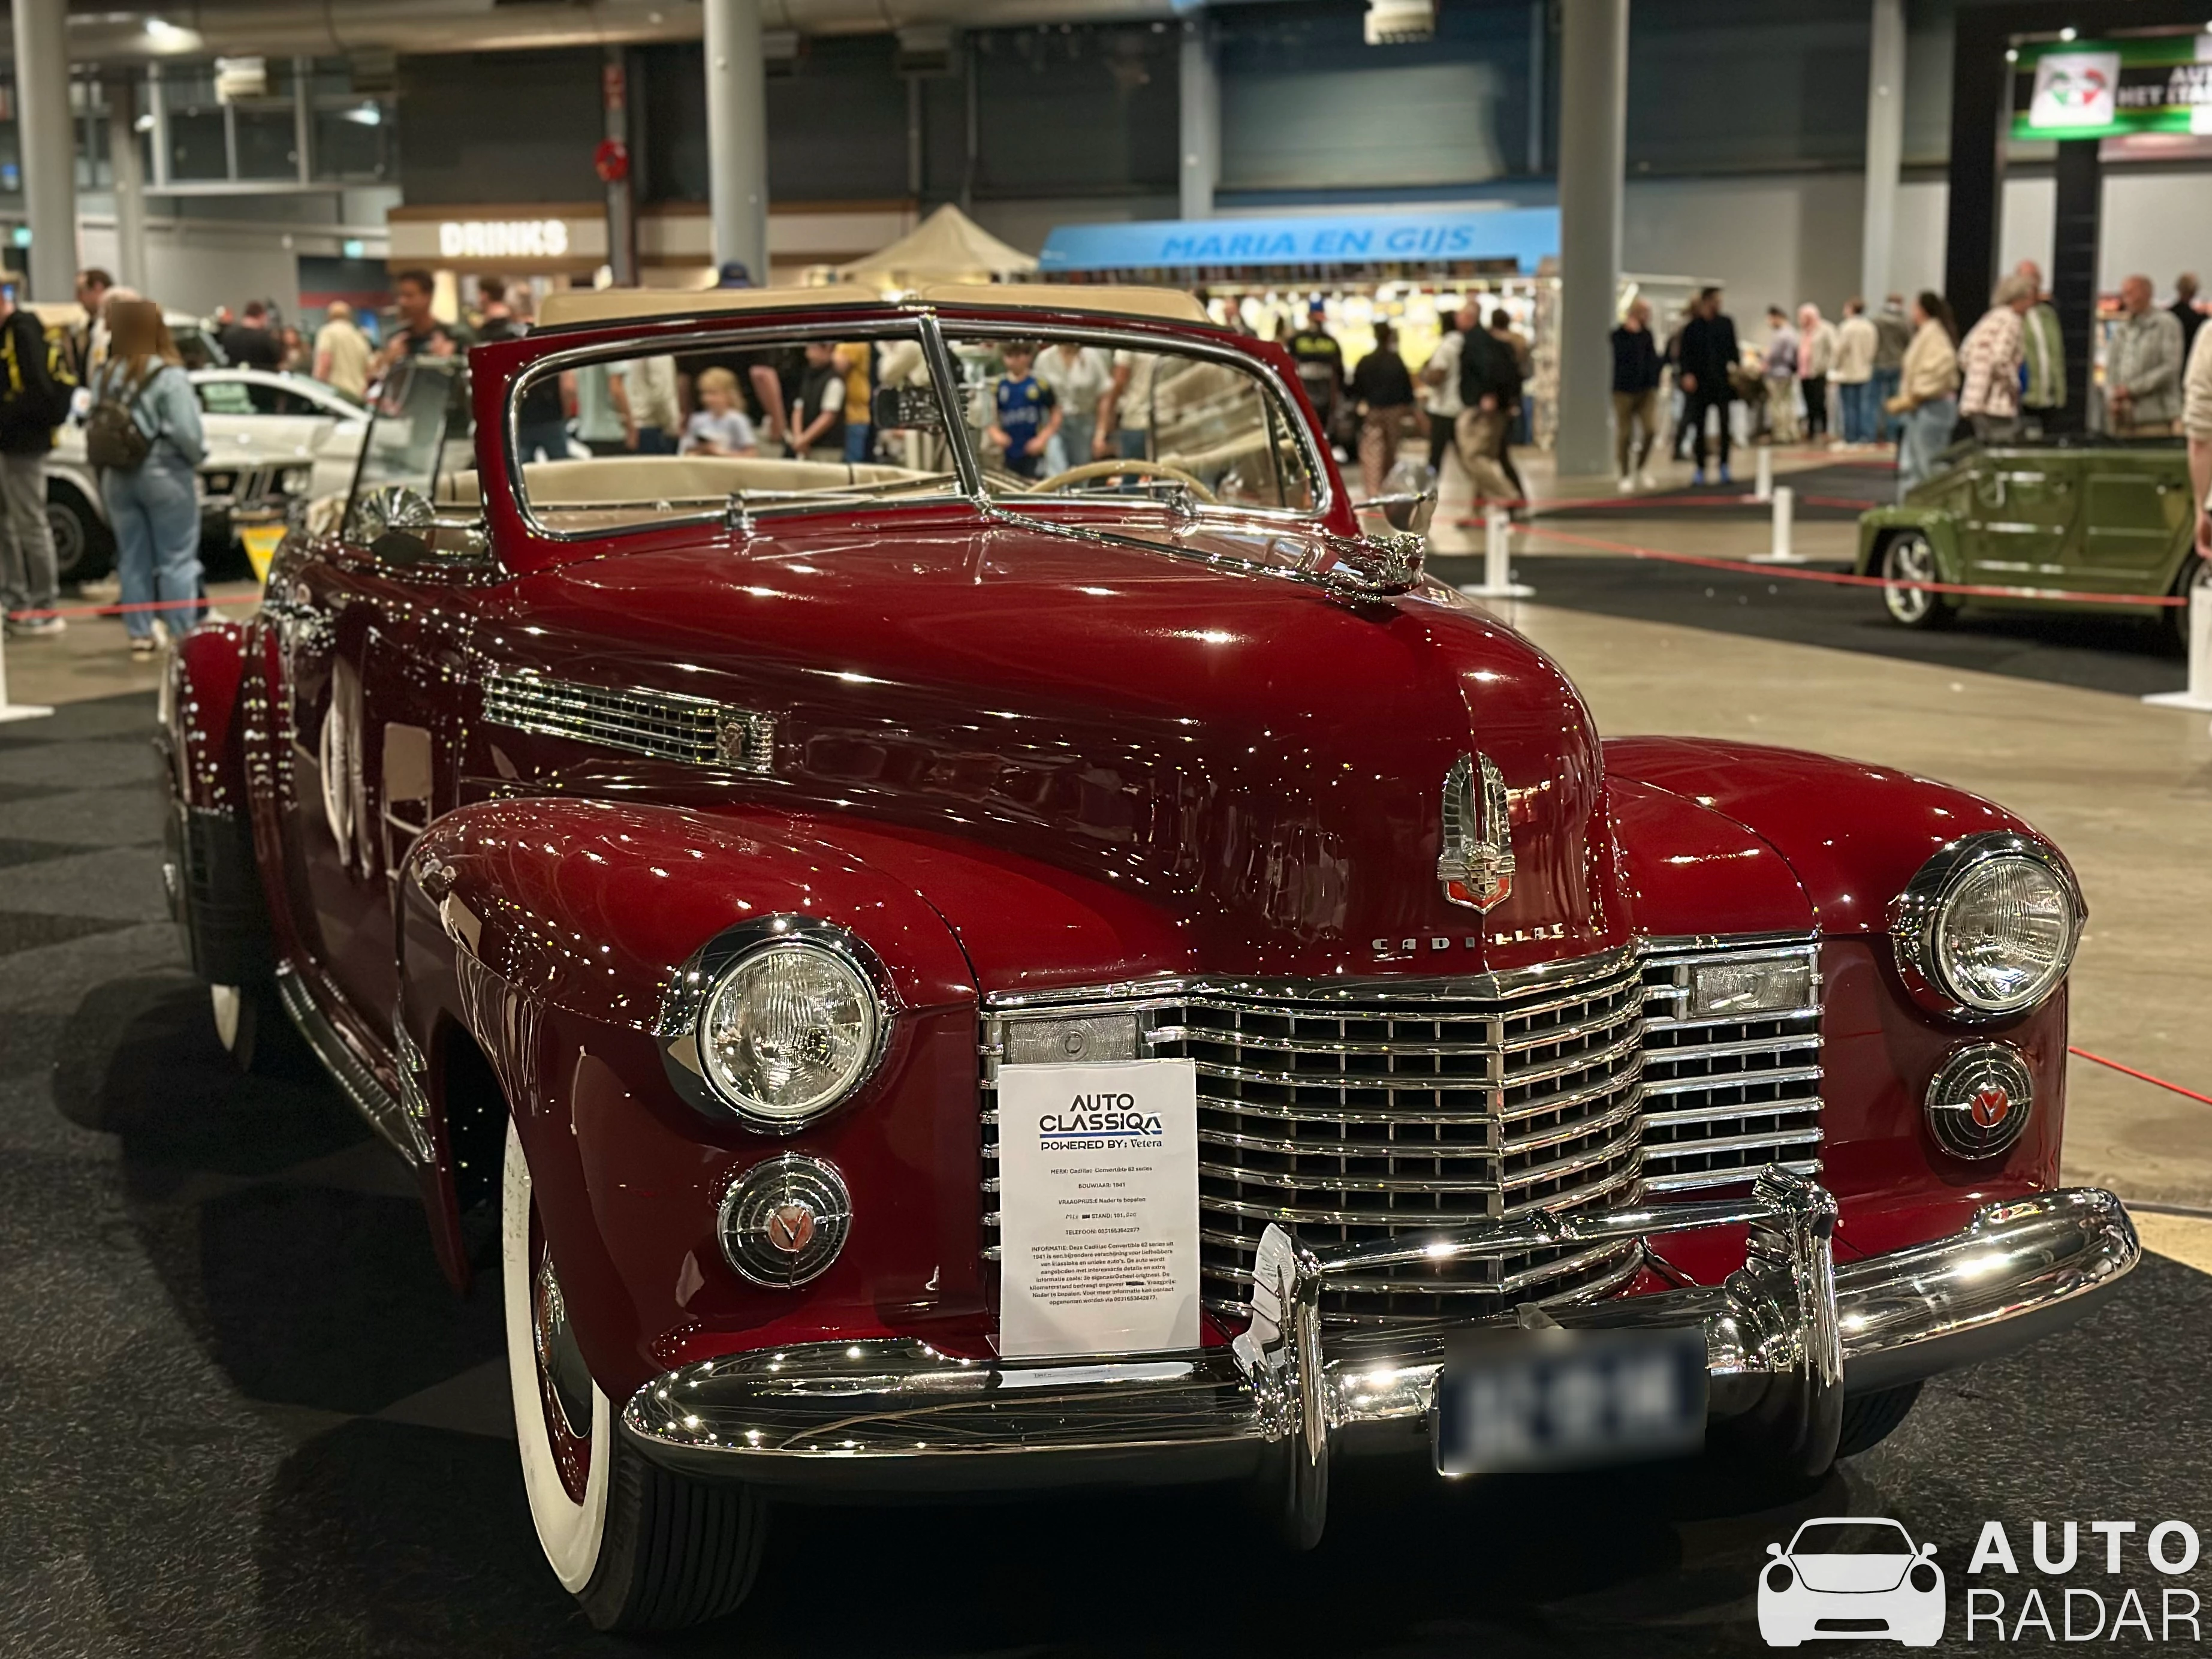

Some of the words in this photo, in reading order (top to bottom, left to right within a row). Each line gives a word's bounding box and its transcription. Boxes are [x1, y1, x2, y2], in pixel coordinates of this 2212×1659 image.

[439, 219, 568, 257] DRINKS
[1162, 231, 1297, 258] MARIA
[1309, 228, 1372, 254] EN
[1386, 225, 1475, 254] GIJS
[1372, 923, 1564, 950] CADILLAC
[1070, 1093, 1134, 1112] AUTO
[1039, 1112, 1162, 1134] CLASSIQA
[1041, 1140, 1104, 1151] POWERED
[1107, 1139, 1127, 1148] BY:
[1131, 1139, 1162, 1148] Vetera
